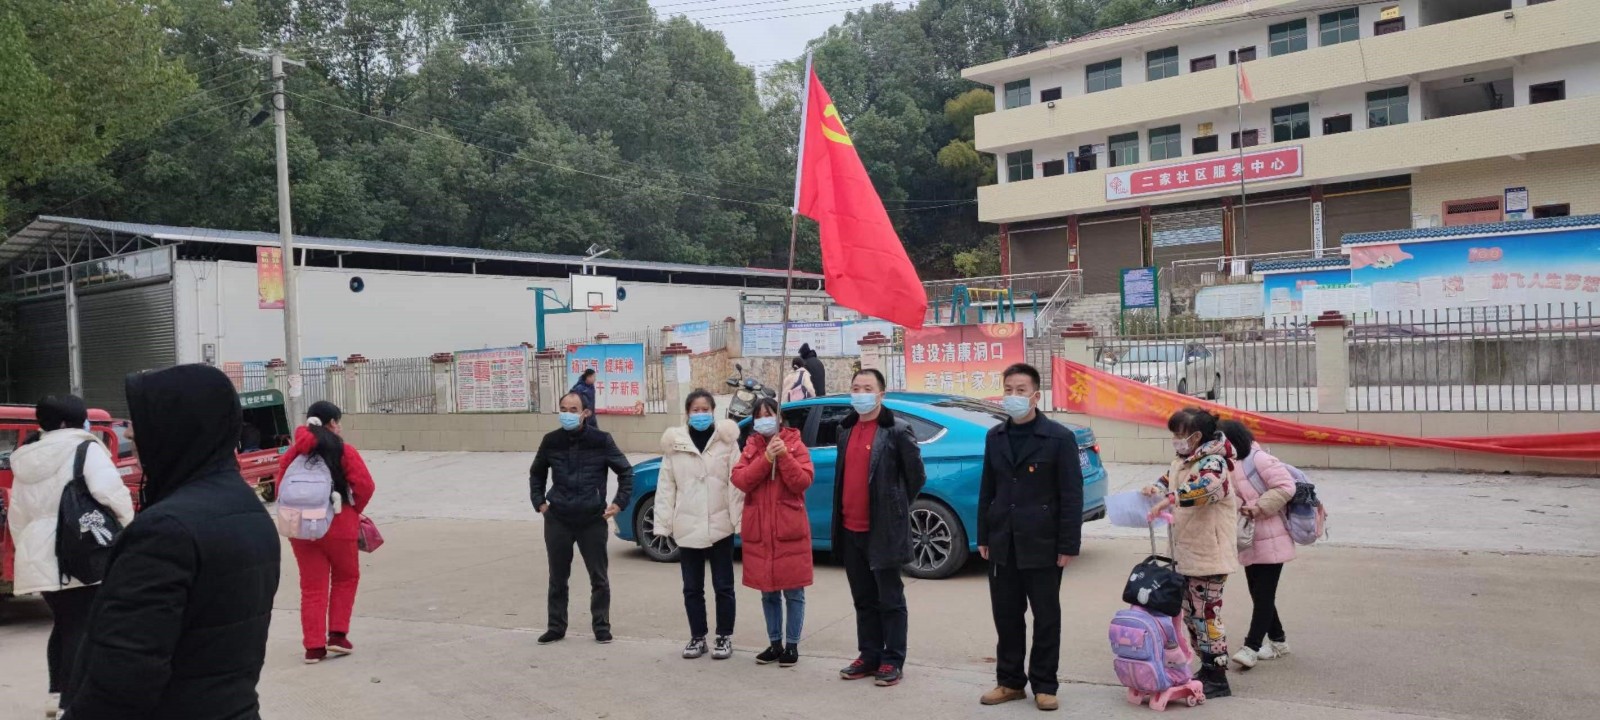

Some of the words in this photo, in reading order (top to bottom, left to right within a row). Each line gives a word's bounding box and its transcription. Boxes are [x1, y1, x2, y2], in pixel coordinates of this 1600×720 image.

[1141, 157, 1286, 188] 二家社区服务中心
[1491, 272, 1600, 293] 放飞人生梦想
[911, 341, 1004, 364] 建设清廉洞口
